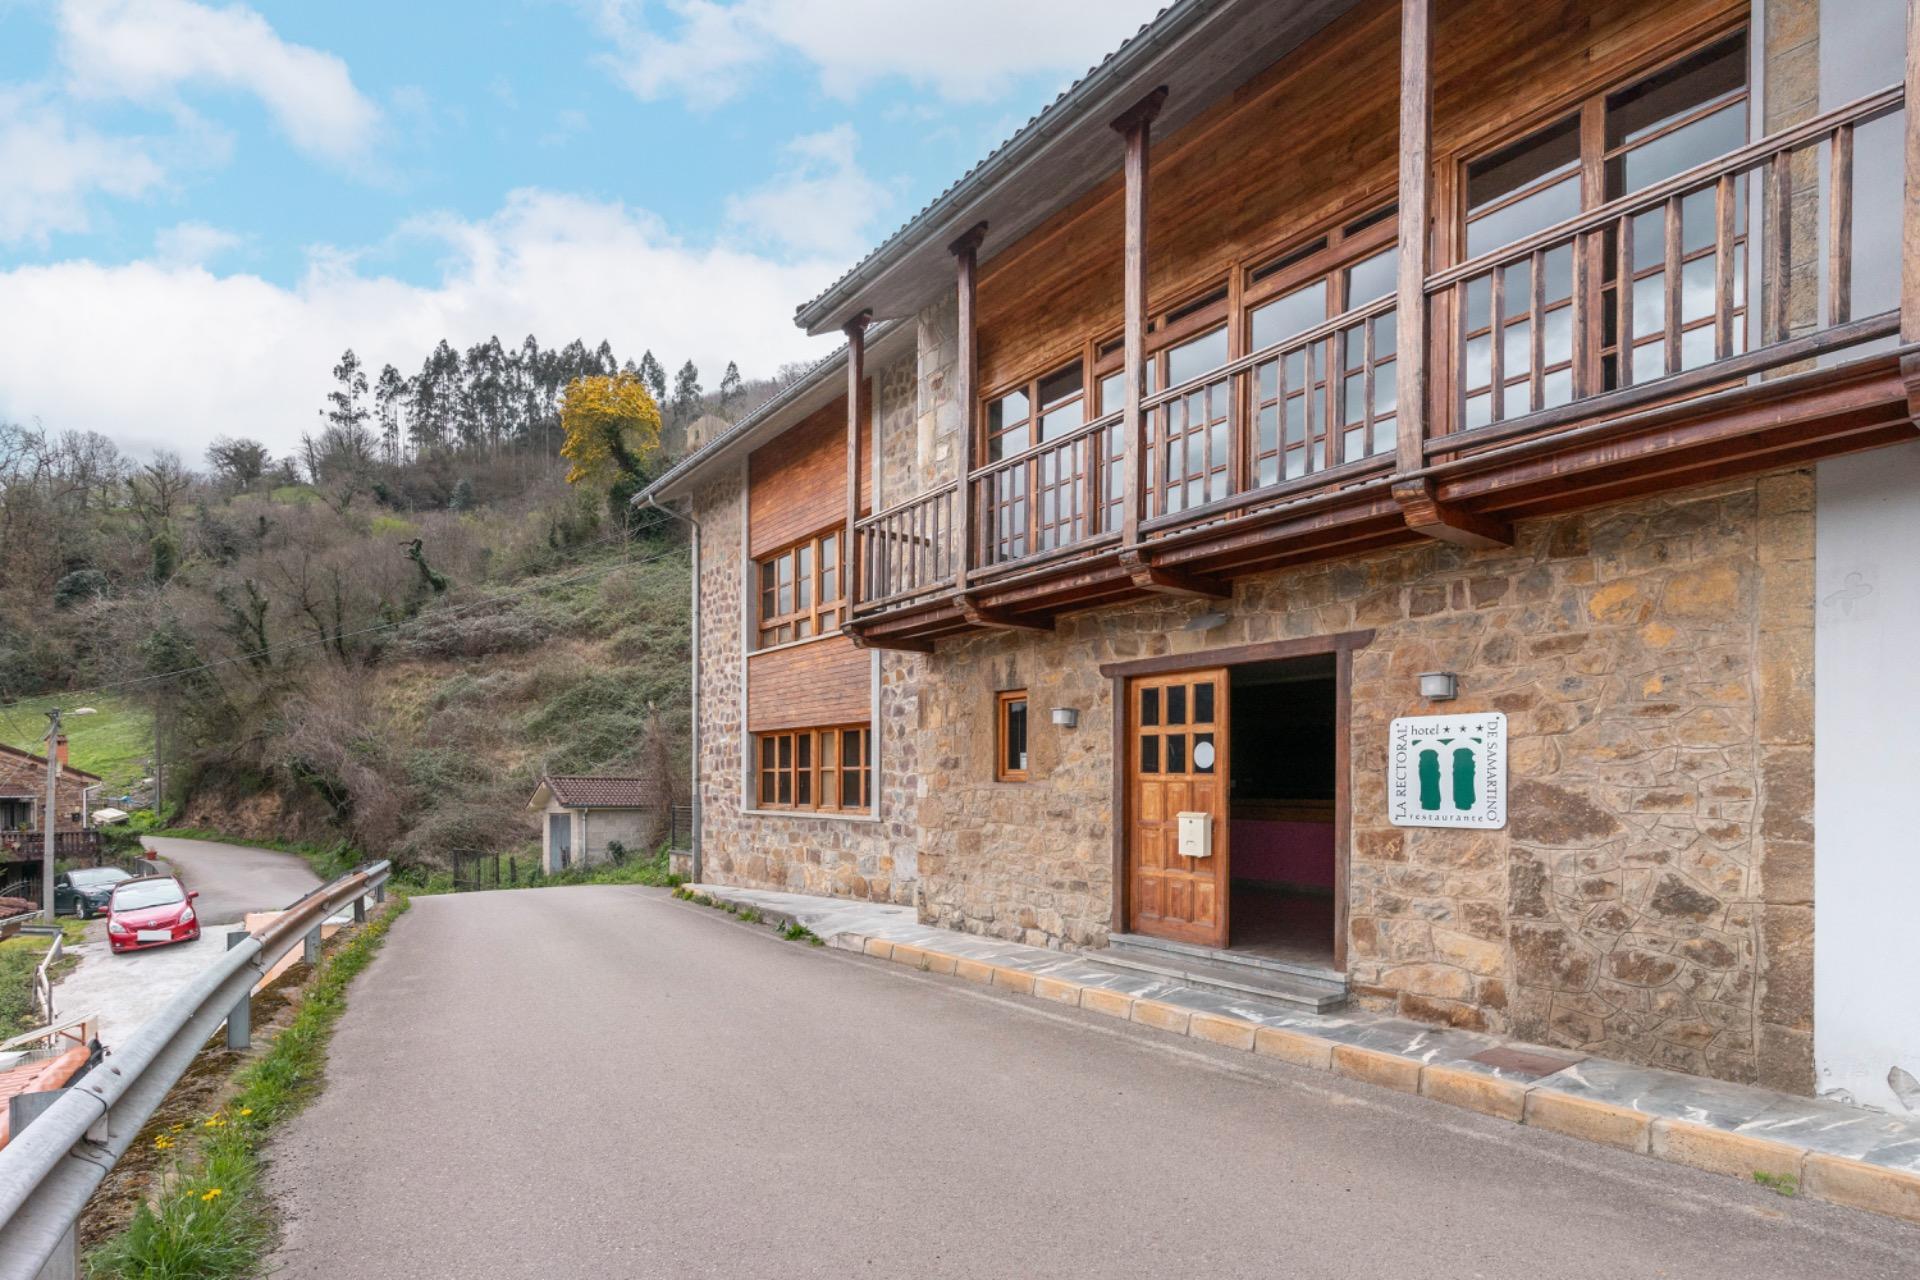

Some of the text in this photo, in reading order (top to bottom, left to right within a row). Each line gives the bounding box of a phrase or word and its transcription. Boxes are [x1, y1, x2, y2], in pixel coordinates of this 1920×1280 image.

[1411, 724, 1439, 736] hotel
[1396, 725, 1408, 819] LA RECTORAL
[1486, 721, 1498, 821] DE SAMARTINO
[1409, 814, 1484, 823] restaurante
